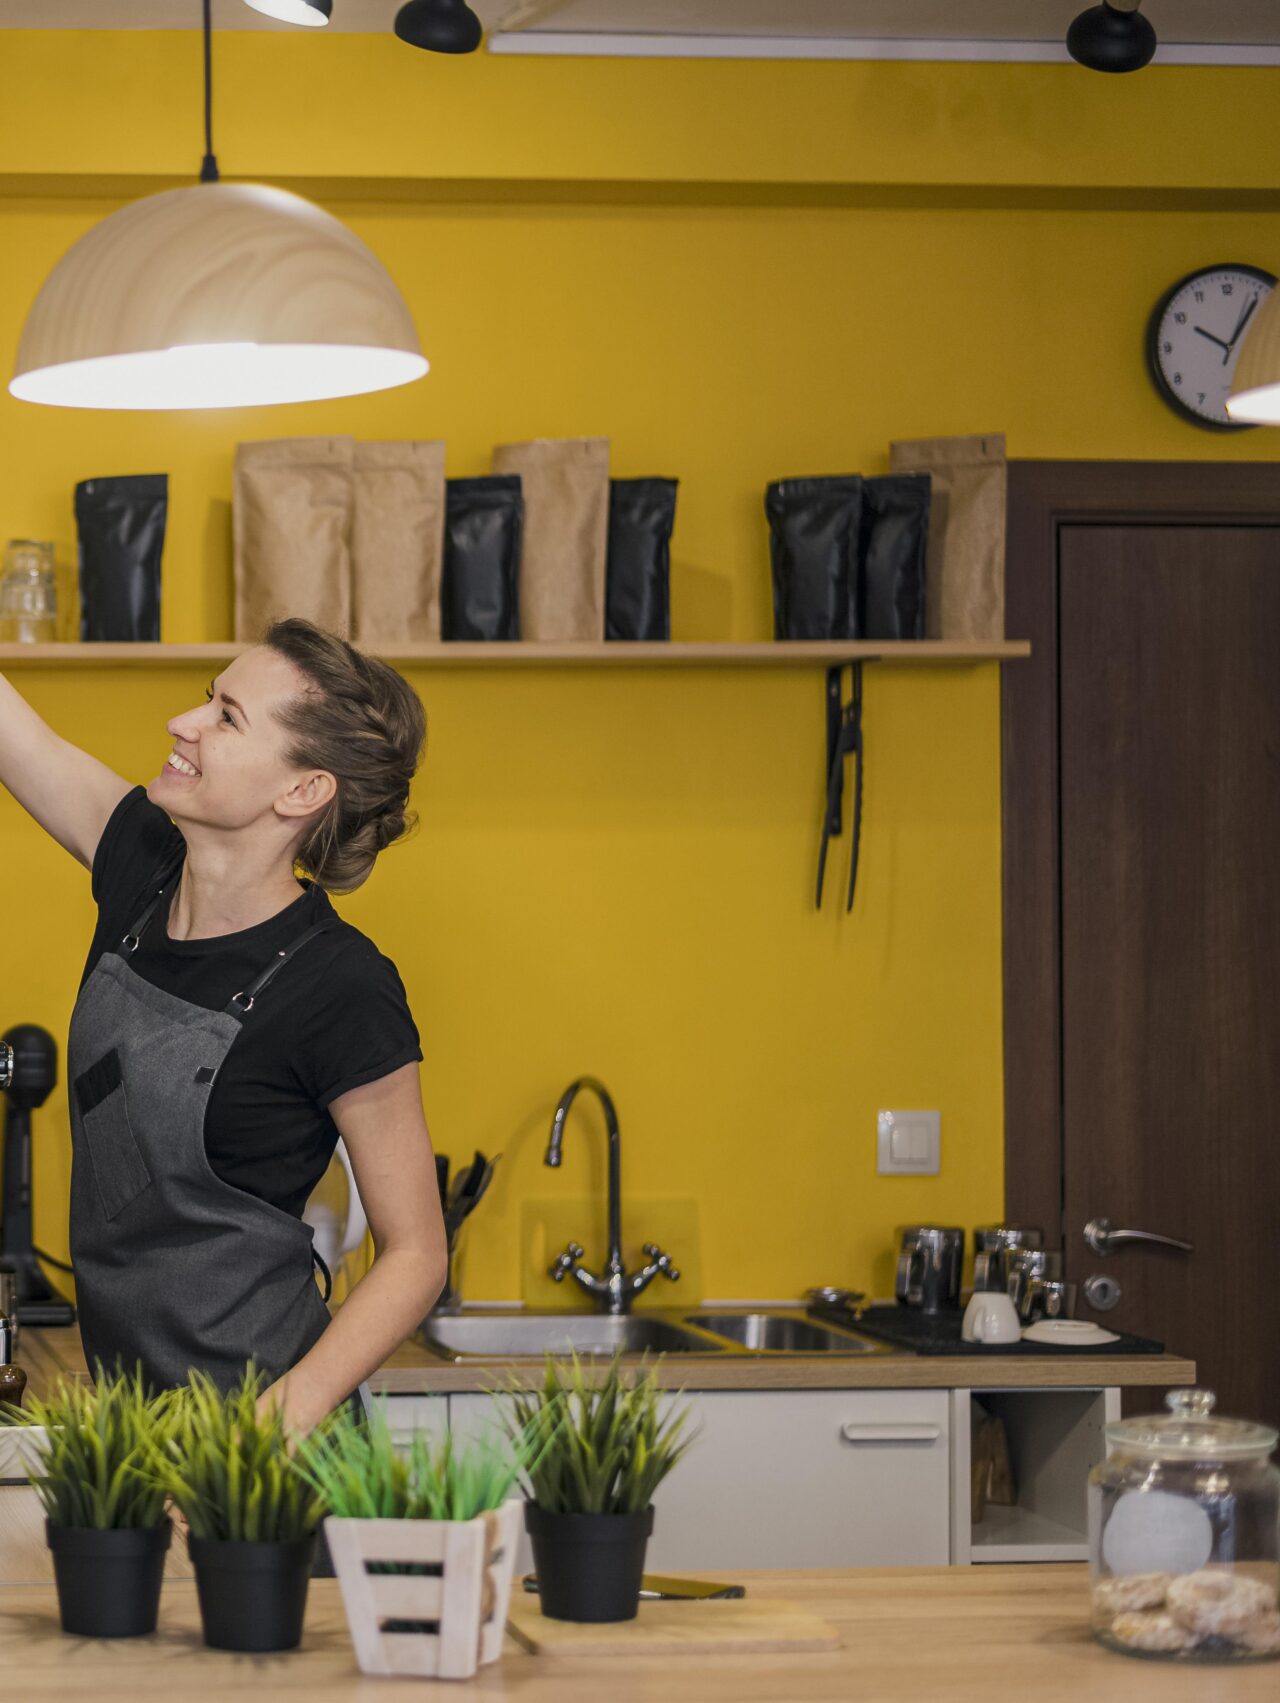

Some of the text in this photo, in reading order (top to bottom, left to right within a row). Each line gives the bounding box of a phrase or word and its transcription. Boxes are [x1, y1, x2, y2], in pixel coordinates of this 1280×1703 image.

[1222, 284, 1232, 295] 12
[1195, 291, 1203, 303] 11
[1174, 312, 1186, 325] 10
